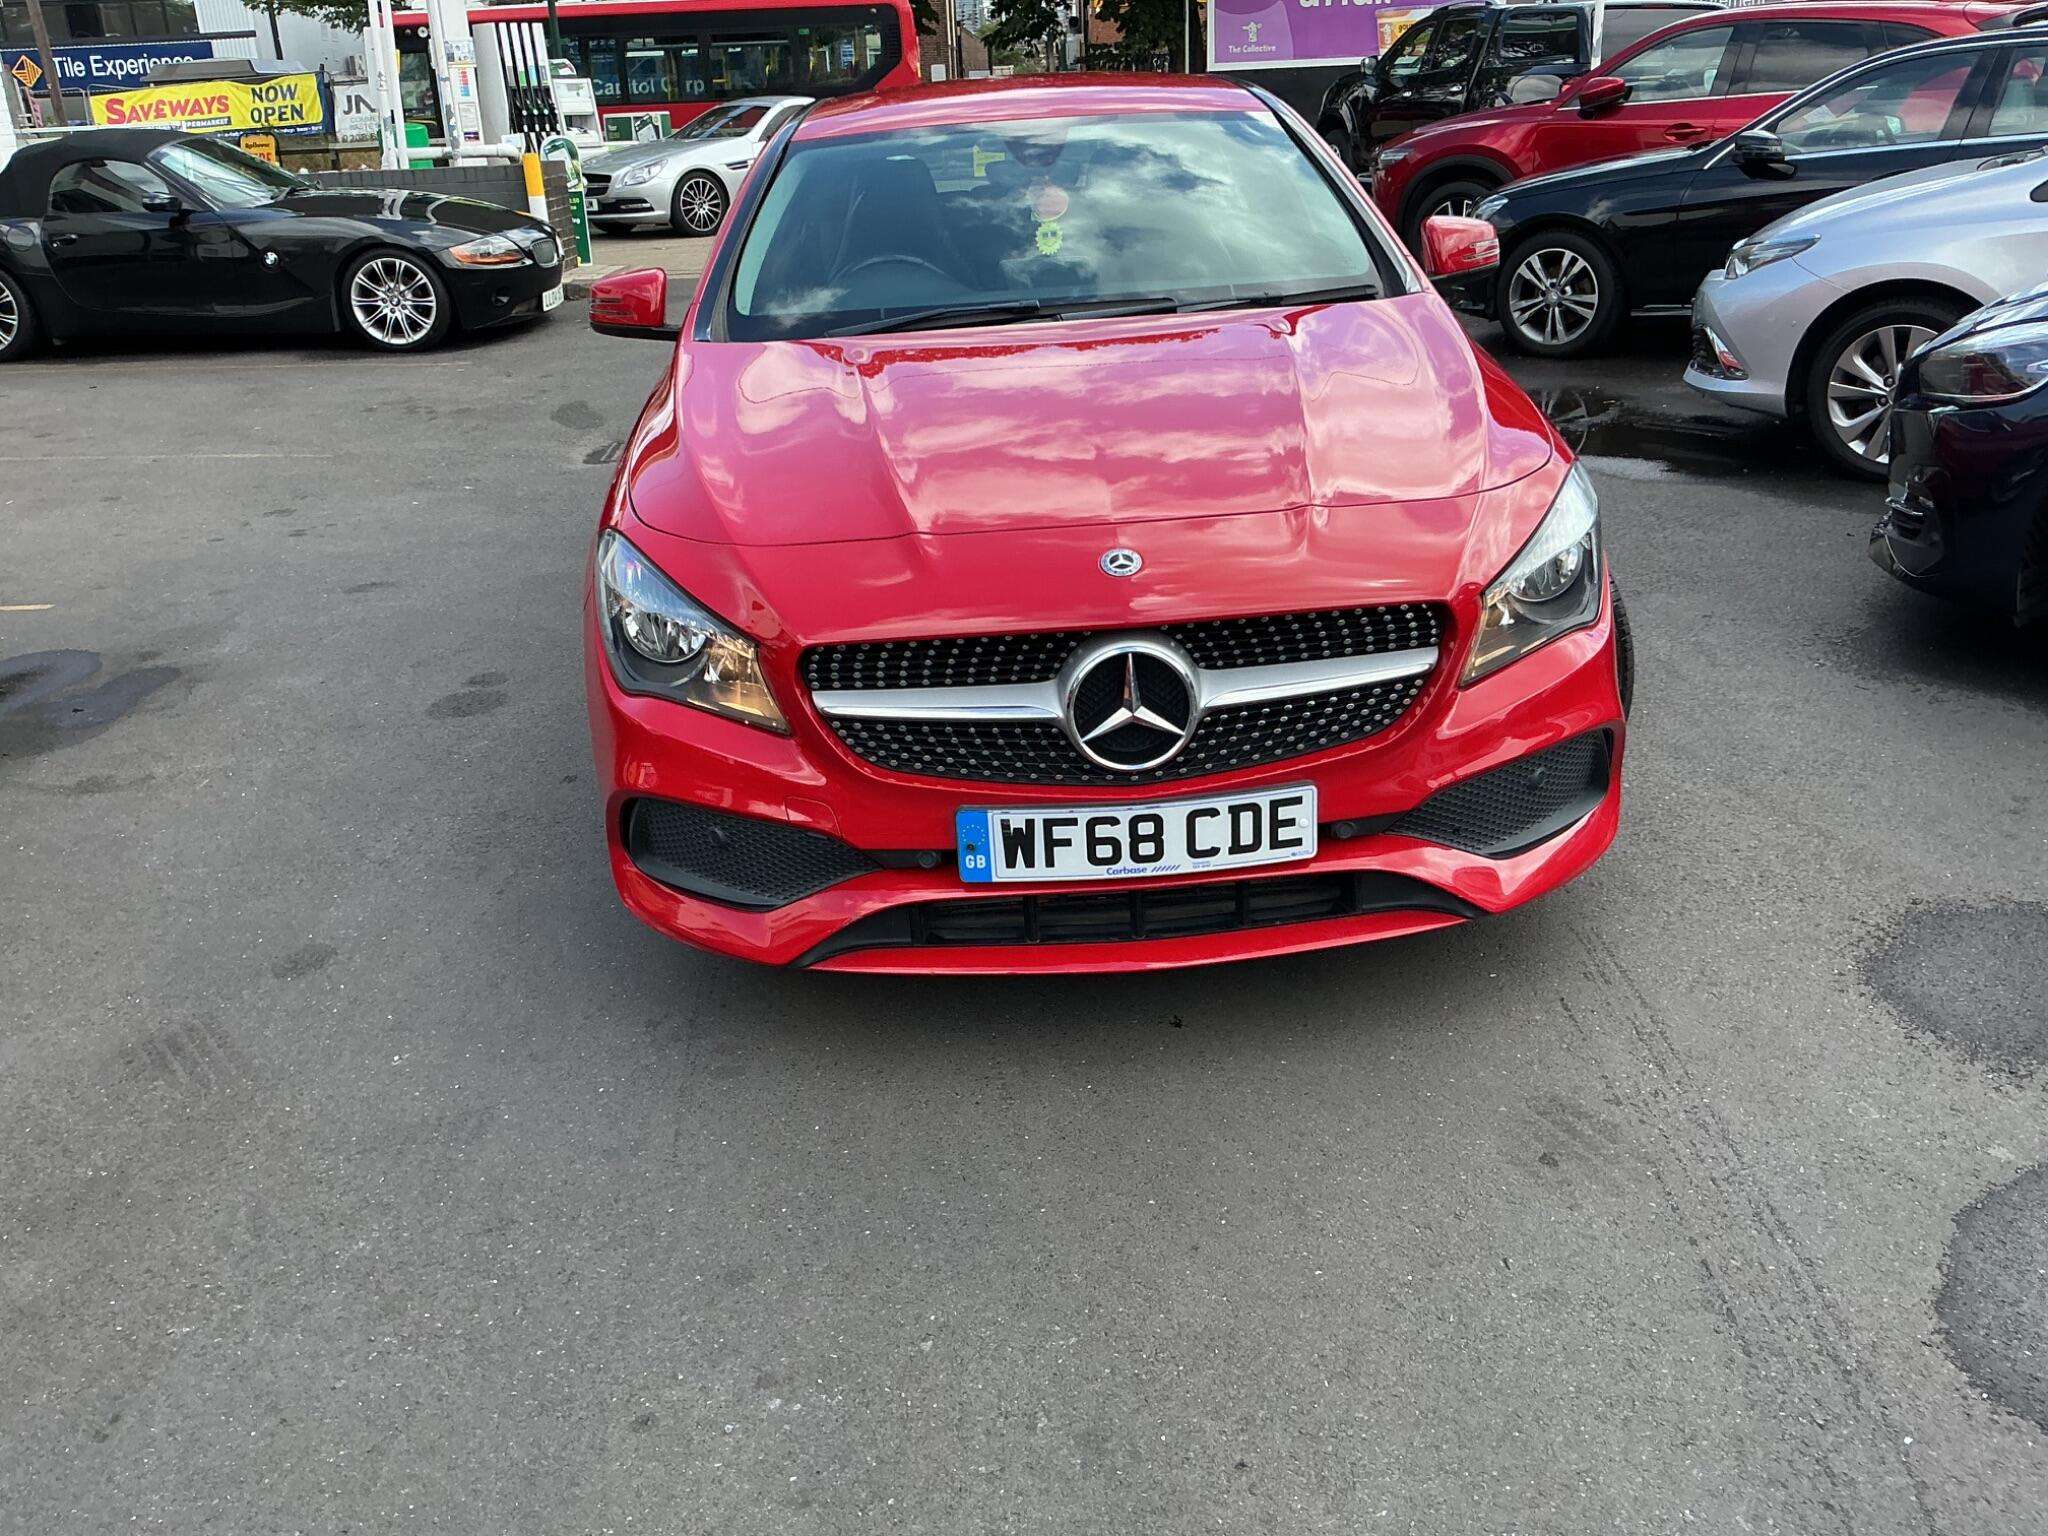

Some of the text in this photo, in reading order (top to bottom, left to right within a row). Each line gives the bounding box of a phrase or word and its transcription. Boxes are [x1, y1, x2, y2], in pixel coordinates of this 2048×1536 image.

[1228, 44, 1276, 53] The Collective
[53, 56, 86, 78] Tile
[250, 83, 299, 104] NOW
[250, 103, 304, 124] OPEN
[1000, 796, 1303, 869] WF68 CDE
[965, 854, 986, 869] GB
[1106, 865, 1147, 876] Carbase
